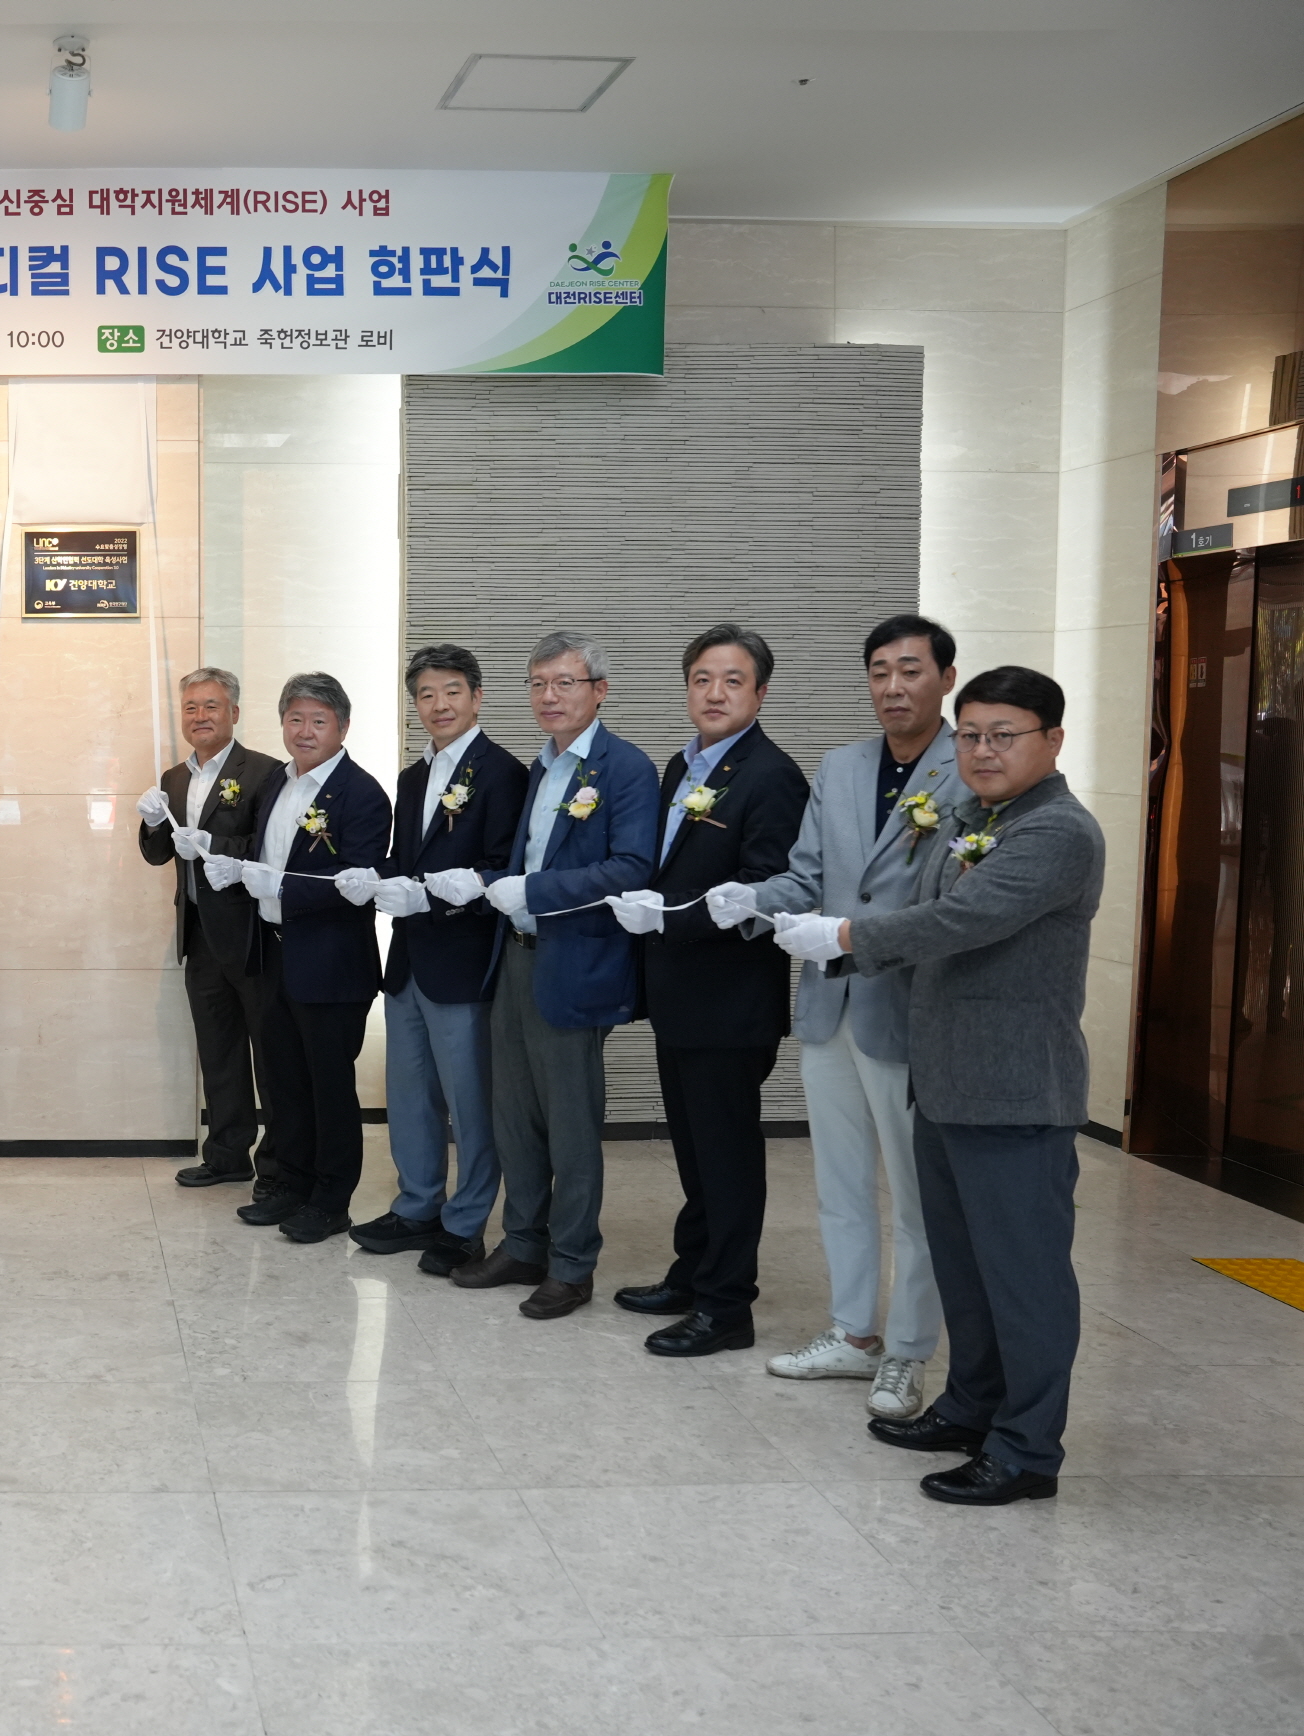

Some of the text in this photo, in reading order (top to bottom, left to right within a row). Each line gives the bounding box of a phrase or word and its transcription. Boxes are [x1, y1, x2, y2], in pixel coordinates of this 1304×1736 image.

[88, 187, 328, 217] 대학지원체계(RISE)
[341, 188, 391, 217] 사업
[95, 245, 229, 297] RISE
[252, 245, 345, 297] 사업
[368, 244, 512, 299] 현판식
[549, 280, 588, 288] DAEJEON
[547, 290, 643, 306] 대전RISE센터
[7, 330, 65, 349] 10:00
[101, 328, 394, 351] 장소 건양대학교 죽헌정보관 로비
[1190, 532, 1213, 549] 1호기
[69, 579, 117, 591] 건양대학교
